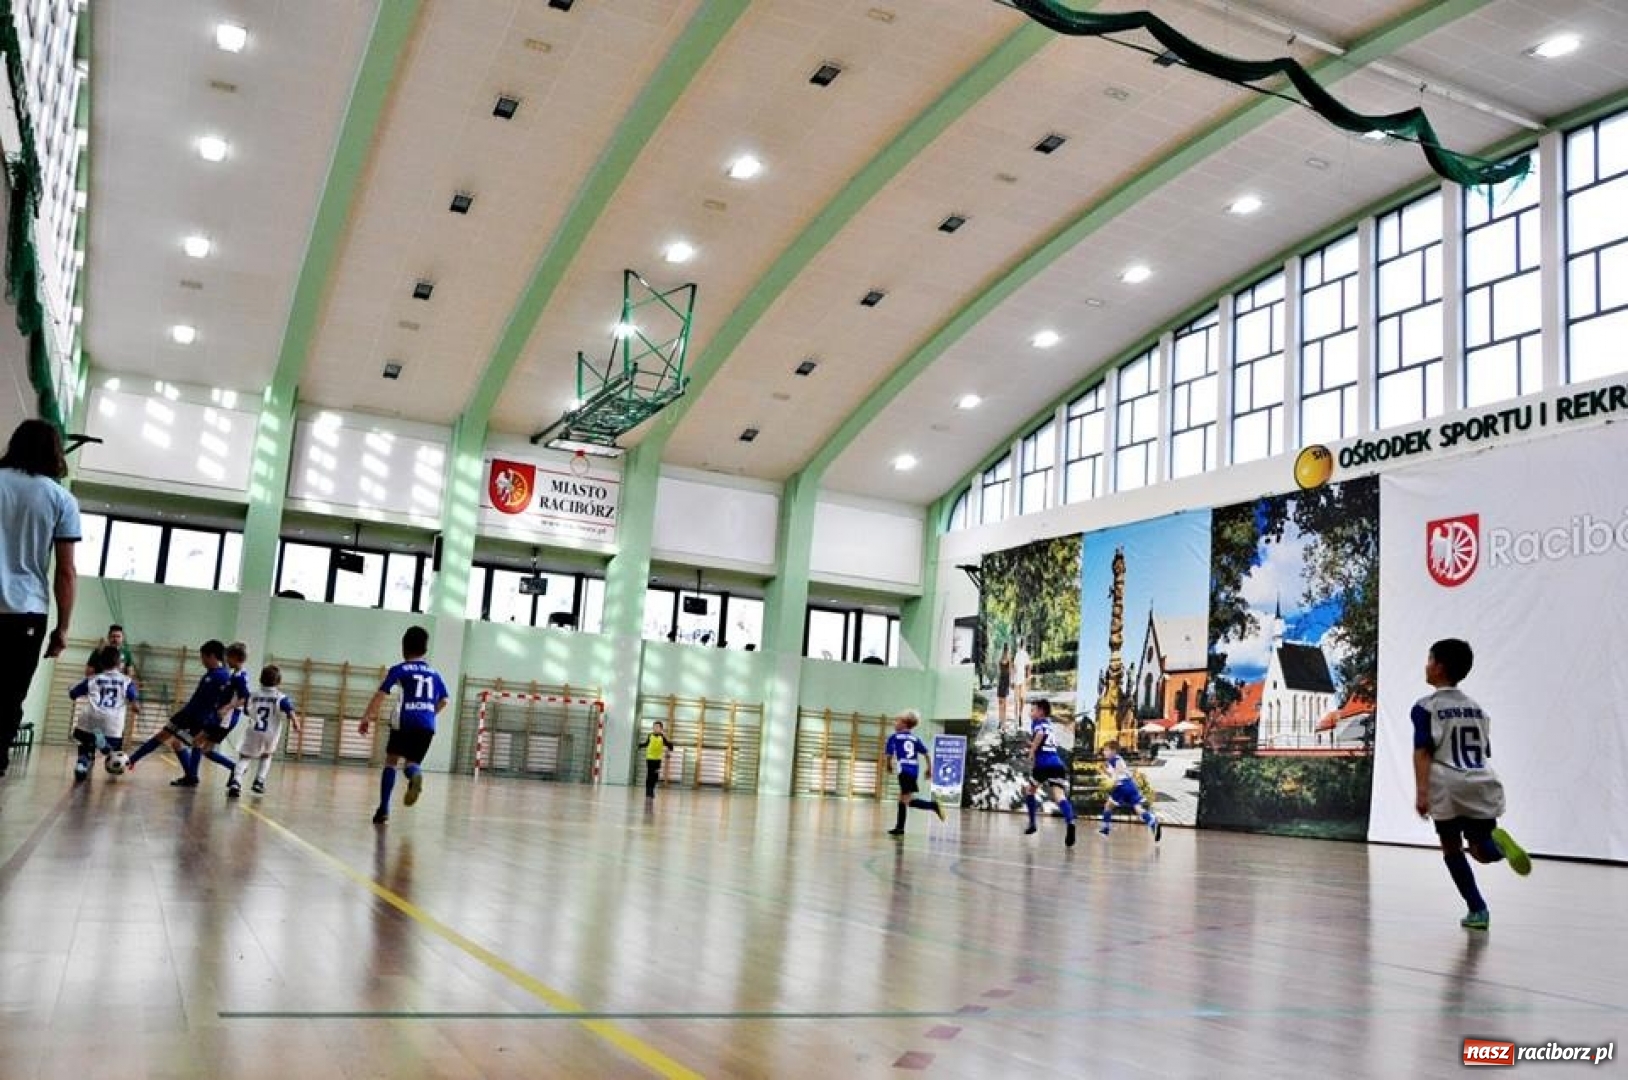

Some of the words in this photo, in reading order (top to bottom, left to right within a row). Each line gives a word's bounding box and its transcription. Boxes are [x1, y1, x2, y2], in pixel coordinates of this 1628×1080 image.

[1338, 428, 1431, 469] OŚRODEK
[1439, 404, 1532, 447] SPORTU
[1540, 401, 1547, 426] I
[1556, 384, 1628, 423] REKR
[551, 479, 608, 500] MIASTO
[540, 495, 615, 518] RACIBÓRZ
[412, 674, 434, 700] 71
[254, 706, 270, 732] 3
[903, 740, 915, 759] 9
[1451, 725, 1484, 769] 16
